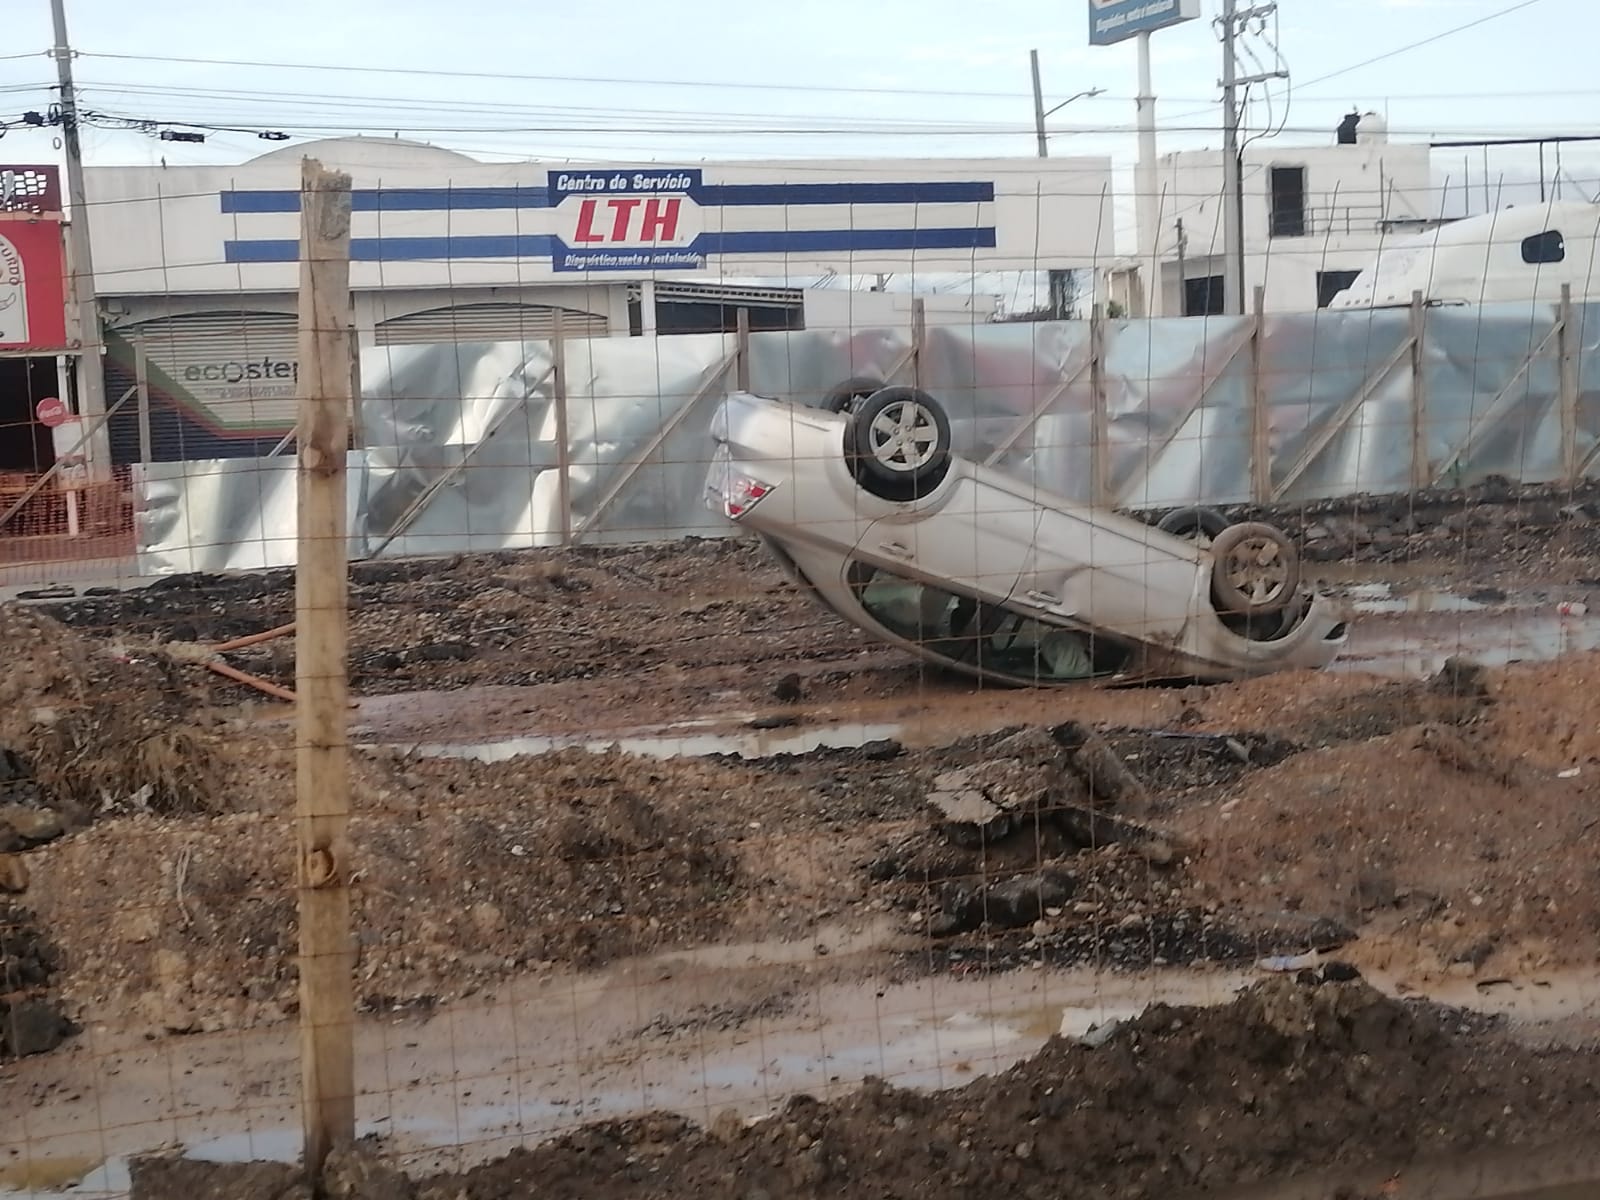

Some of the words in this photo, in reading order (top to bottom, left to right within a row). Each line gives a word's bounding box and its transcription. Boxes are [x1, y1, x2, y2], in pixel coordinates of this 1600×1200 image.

[557, 174, 605, 190] Centro
[609, 174, 628, 190] de
[633, 173, 692, 190] Servicio
[574, 198, 682, 242] LTH
[0, 240, 20, 286] URDO
